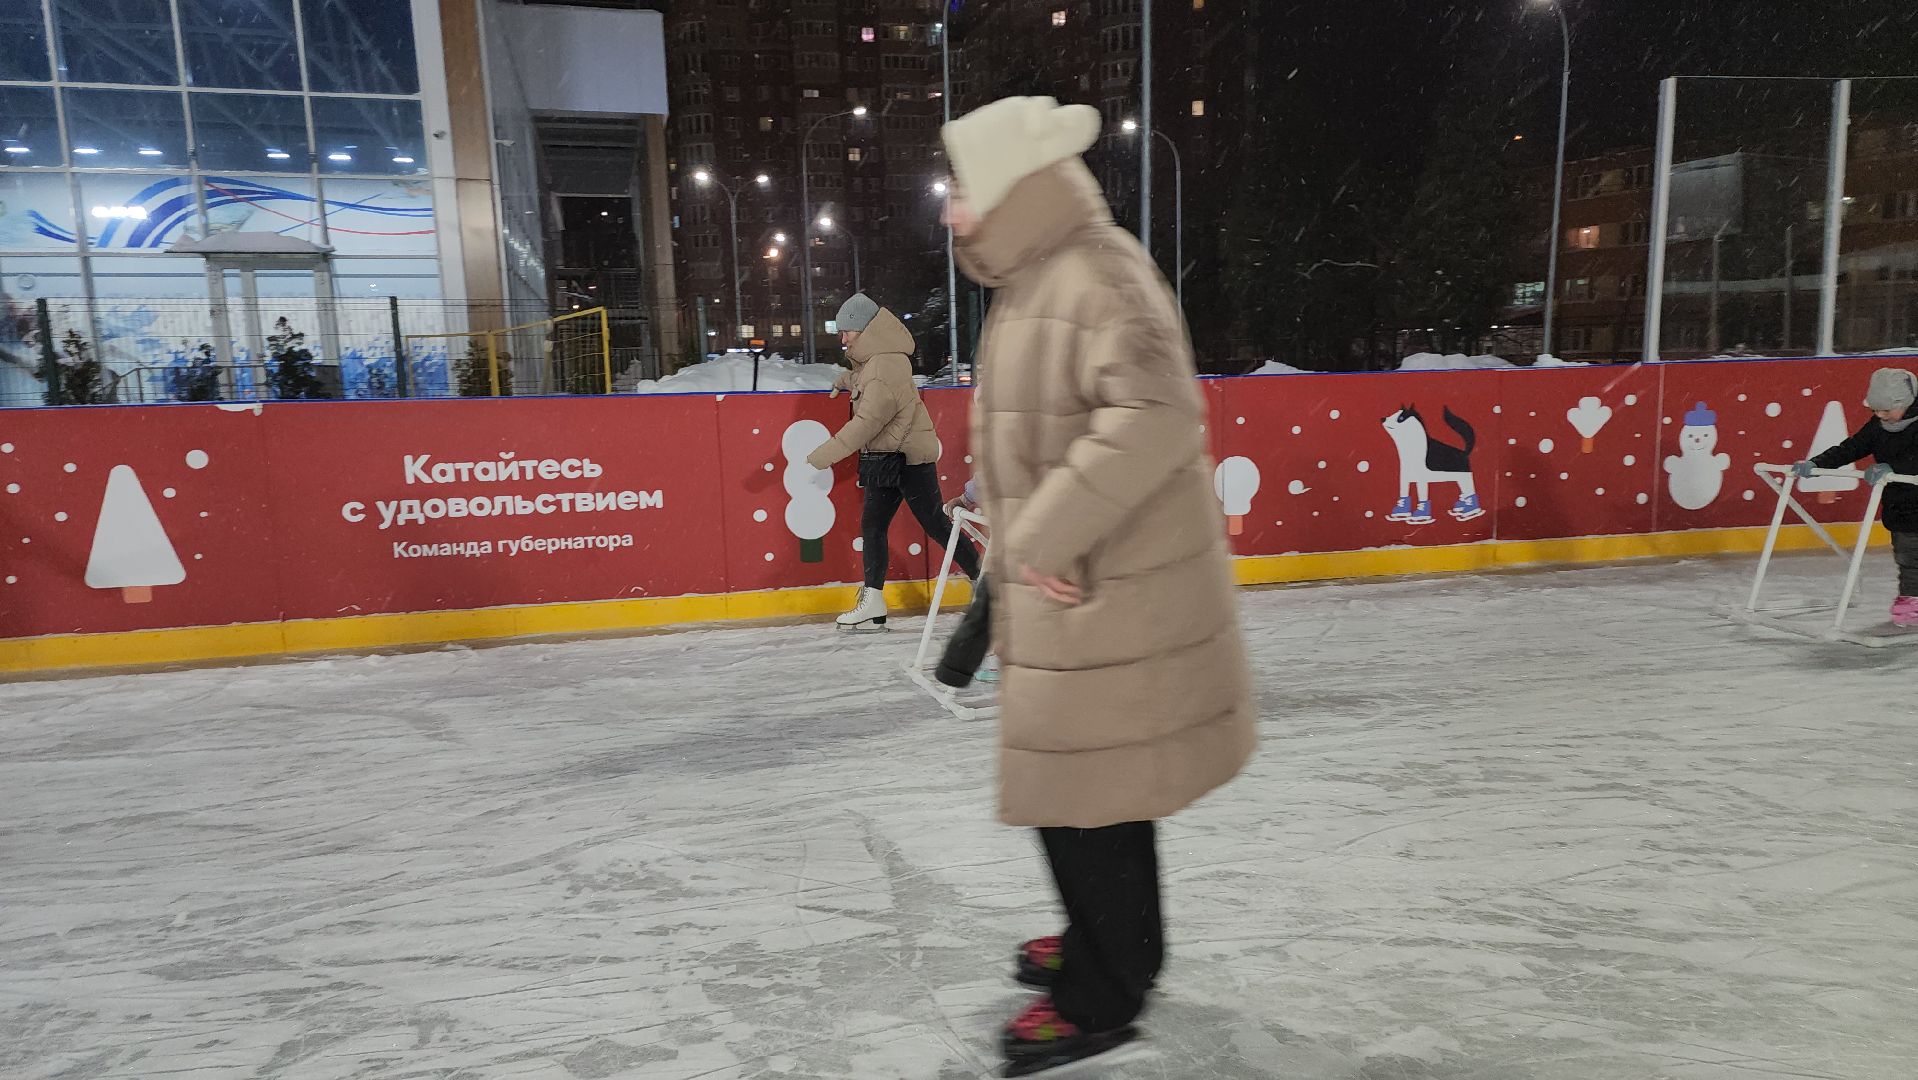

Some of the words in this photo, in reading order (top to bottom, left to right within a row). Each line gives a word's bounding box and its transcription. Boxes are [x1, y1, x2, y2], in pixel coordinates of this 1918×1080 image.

[403, 451, 603, 485] Катайтесь
[341, 501, 367, 523] с
[375, 489, 664, 530] удовольствием
[393, 541, 493, 559] Команда
[497, 533, 634, 557] губернатора
